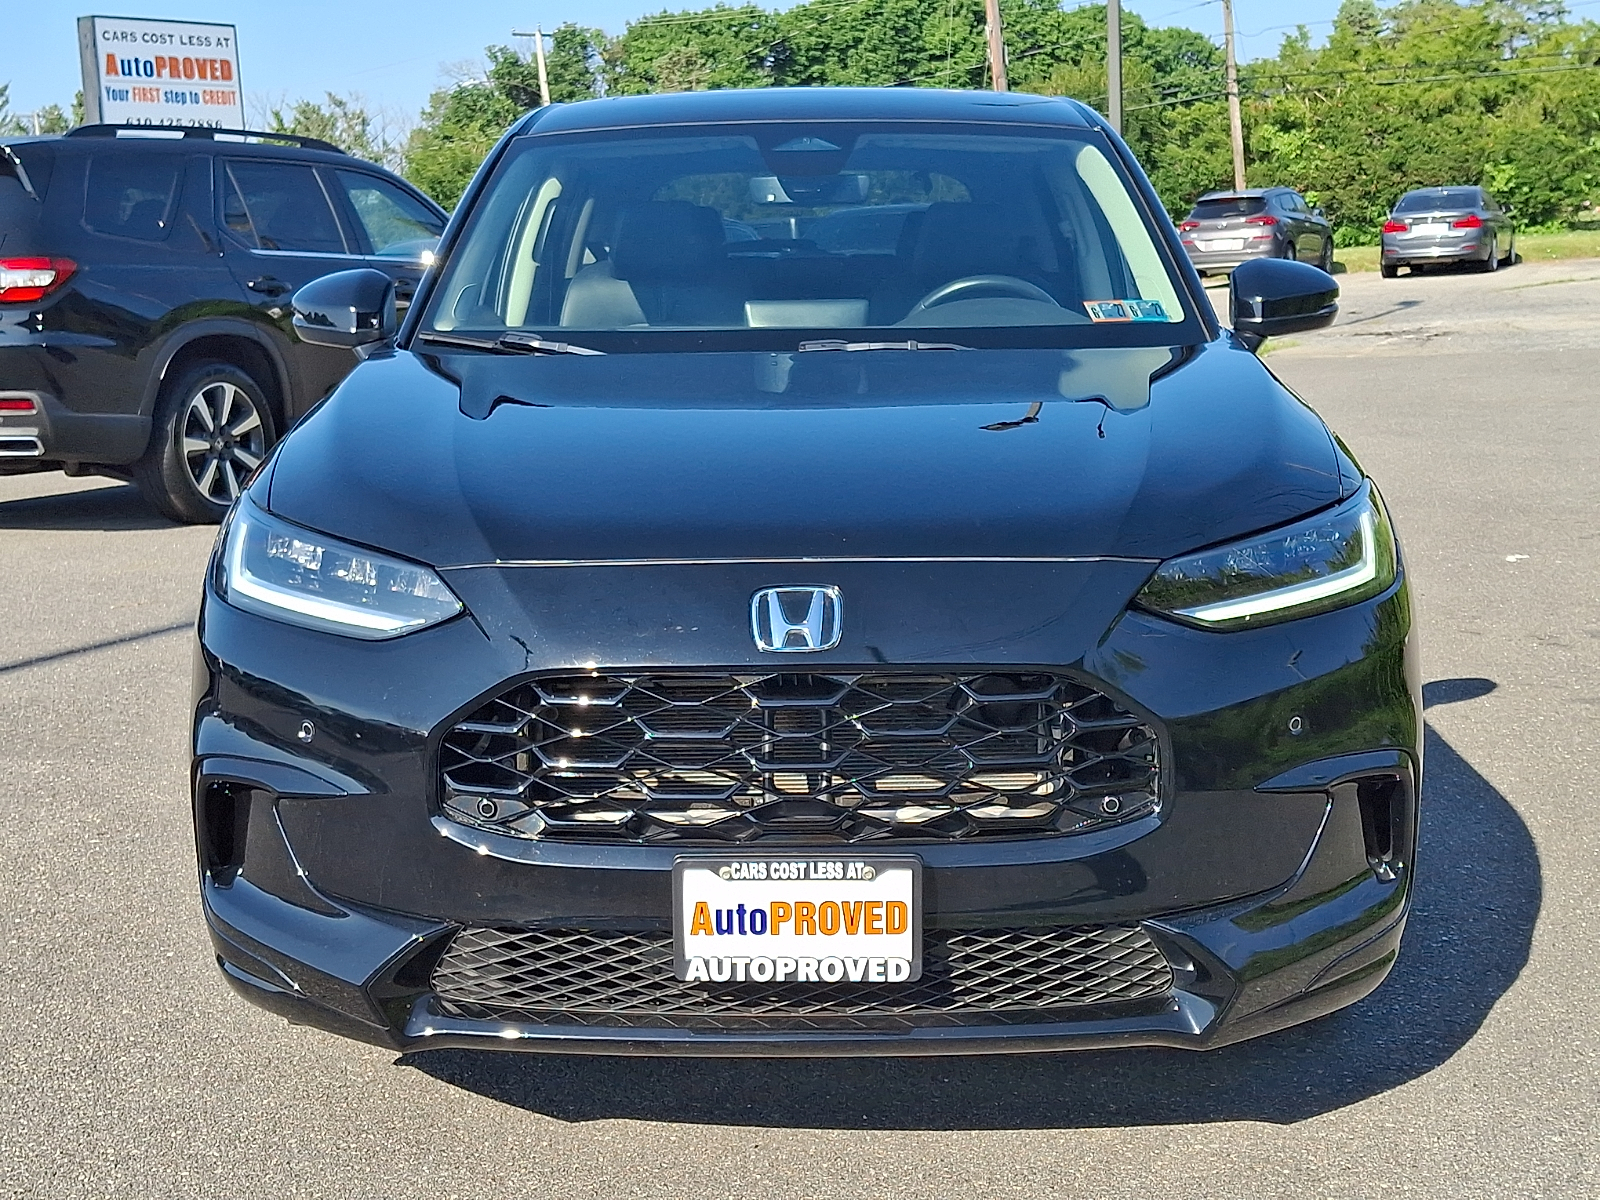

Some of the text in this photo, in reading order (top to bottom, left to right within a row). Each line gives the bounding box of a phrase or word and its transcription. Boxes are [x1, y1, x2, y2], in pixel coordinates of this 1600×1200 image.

[102, 30, 231, 48] CARS COST LESS AT
[105, 53, 234, 81] AutoPROVED
[105, 85, 236, 106] Your FIRST step to CREDIT
[730, 861, 866, 880] CARS COST LESS AT
[690, 900, 909, 936] AutoPROVED
[685, 956, 912, 983] AUTOPROVED
